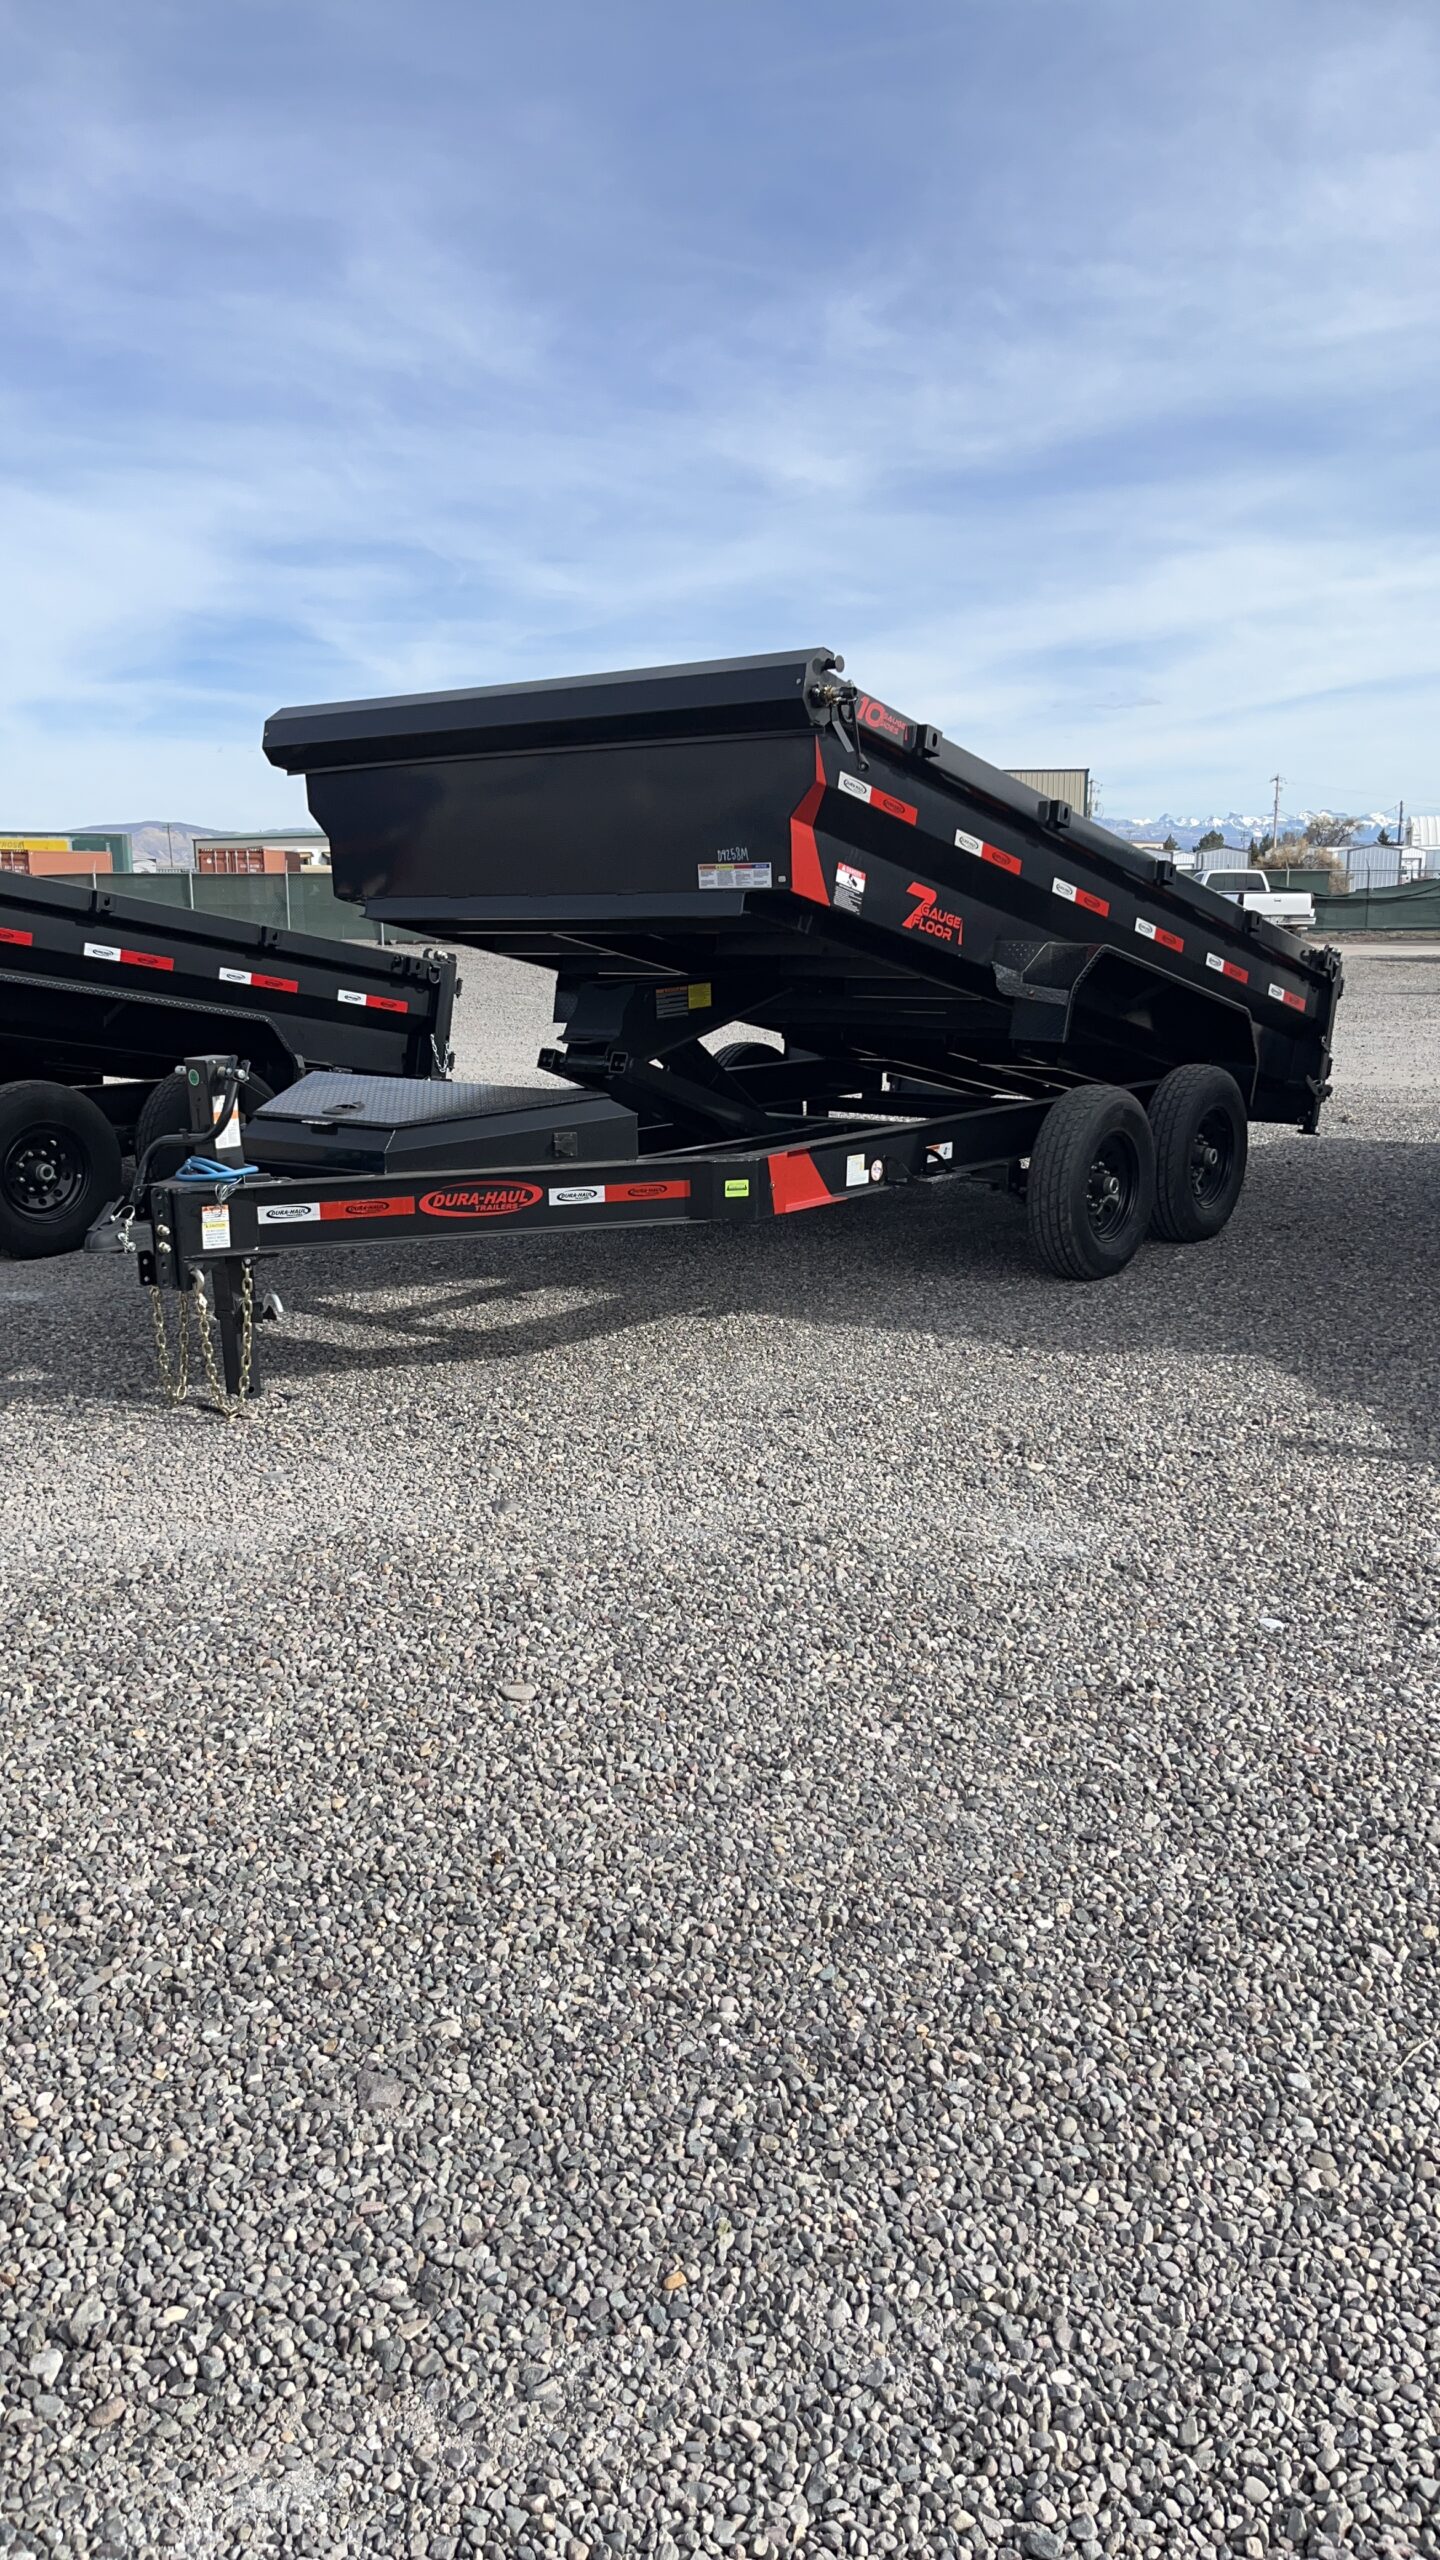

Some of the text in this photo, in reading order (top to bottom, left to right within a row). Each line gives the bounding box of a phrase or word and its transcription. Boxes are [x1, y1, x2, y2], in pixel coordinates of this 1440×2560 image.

[857, 696, 886, 729] 10
[902, 881, 937, 929] 7
[921, 903, 962, 929] GAUGE
[911, 914, 952, 941] FLOOR
[433, 1189, 528, 1207] DURA-HAUL
[474, 1202, 518, 1212] TRAILERS
[271, 1208, 306, 1216] DURA-HAUL
